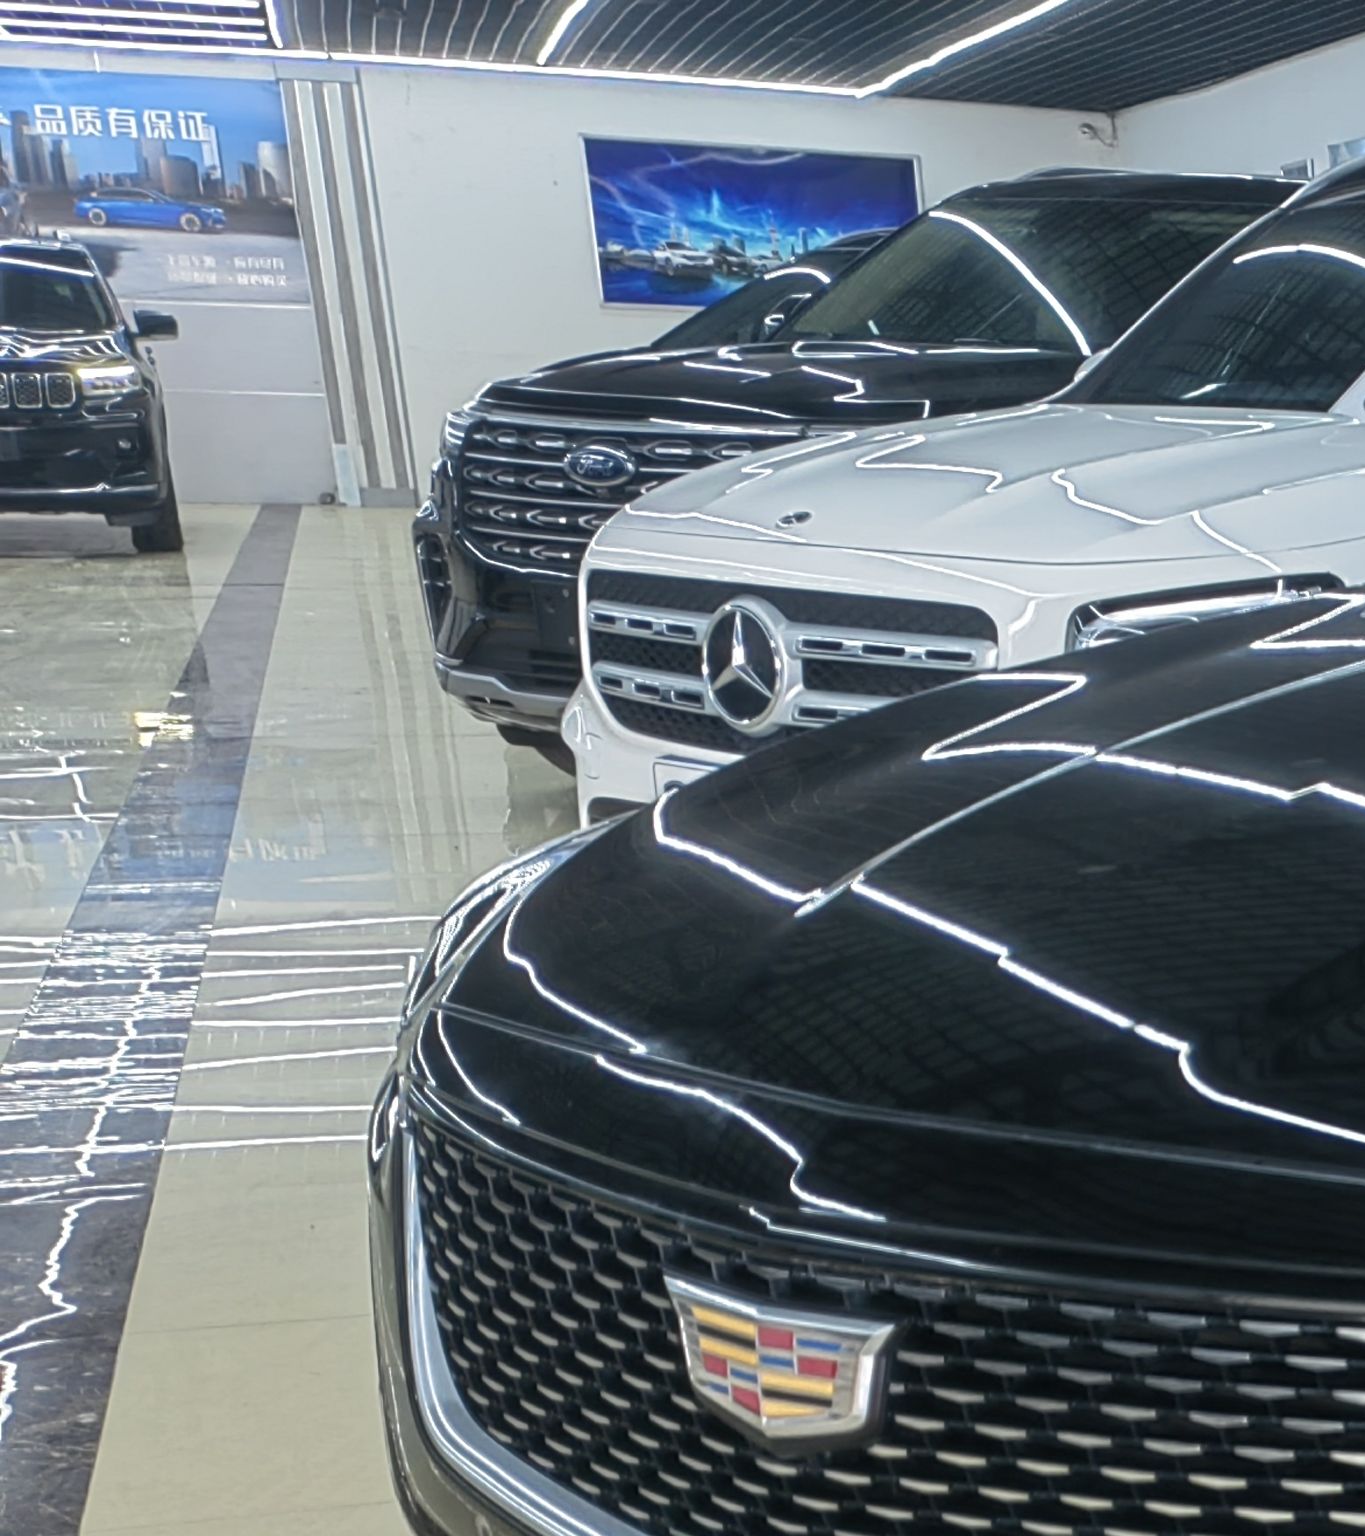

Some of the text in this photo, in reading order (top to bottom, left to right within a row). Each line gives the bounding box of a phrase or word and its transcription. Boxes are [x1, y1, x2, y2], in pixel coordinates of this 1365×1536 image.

[34, 104, 210, 142] 品质有保证
